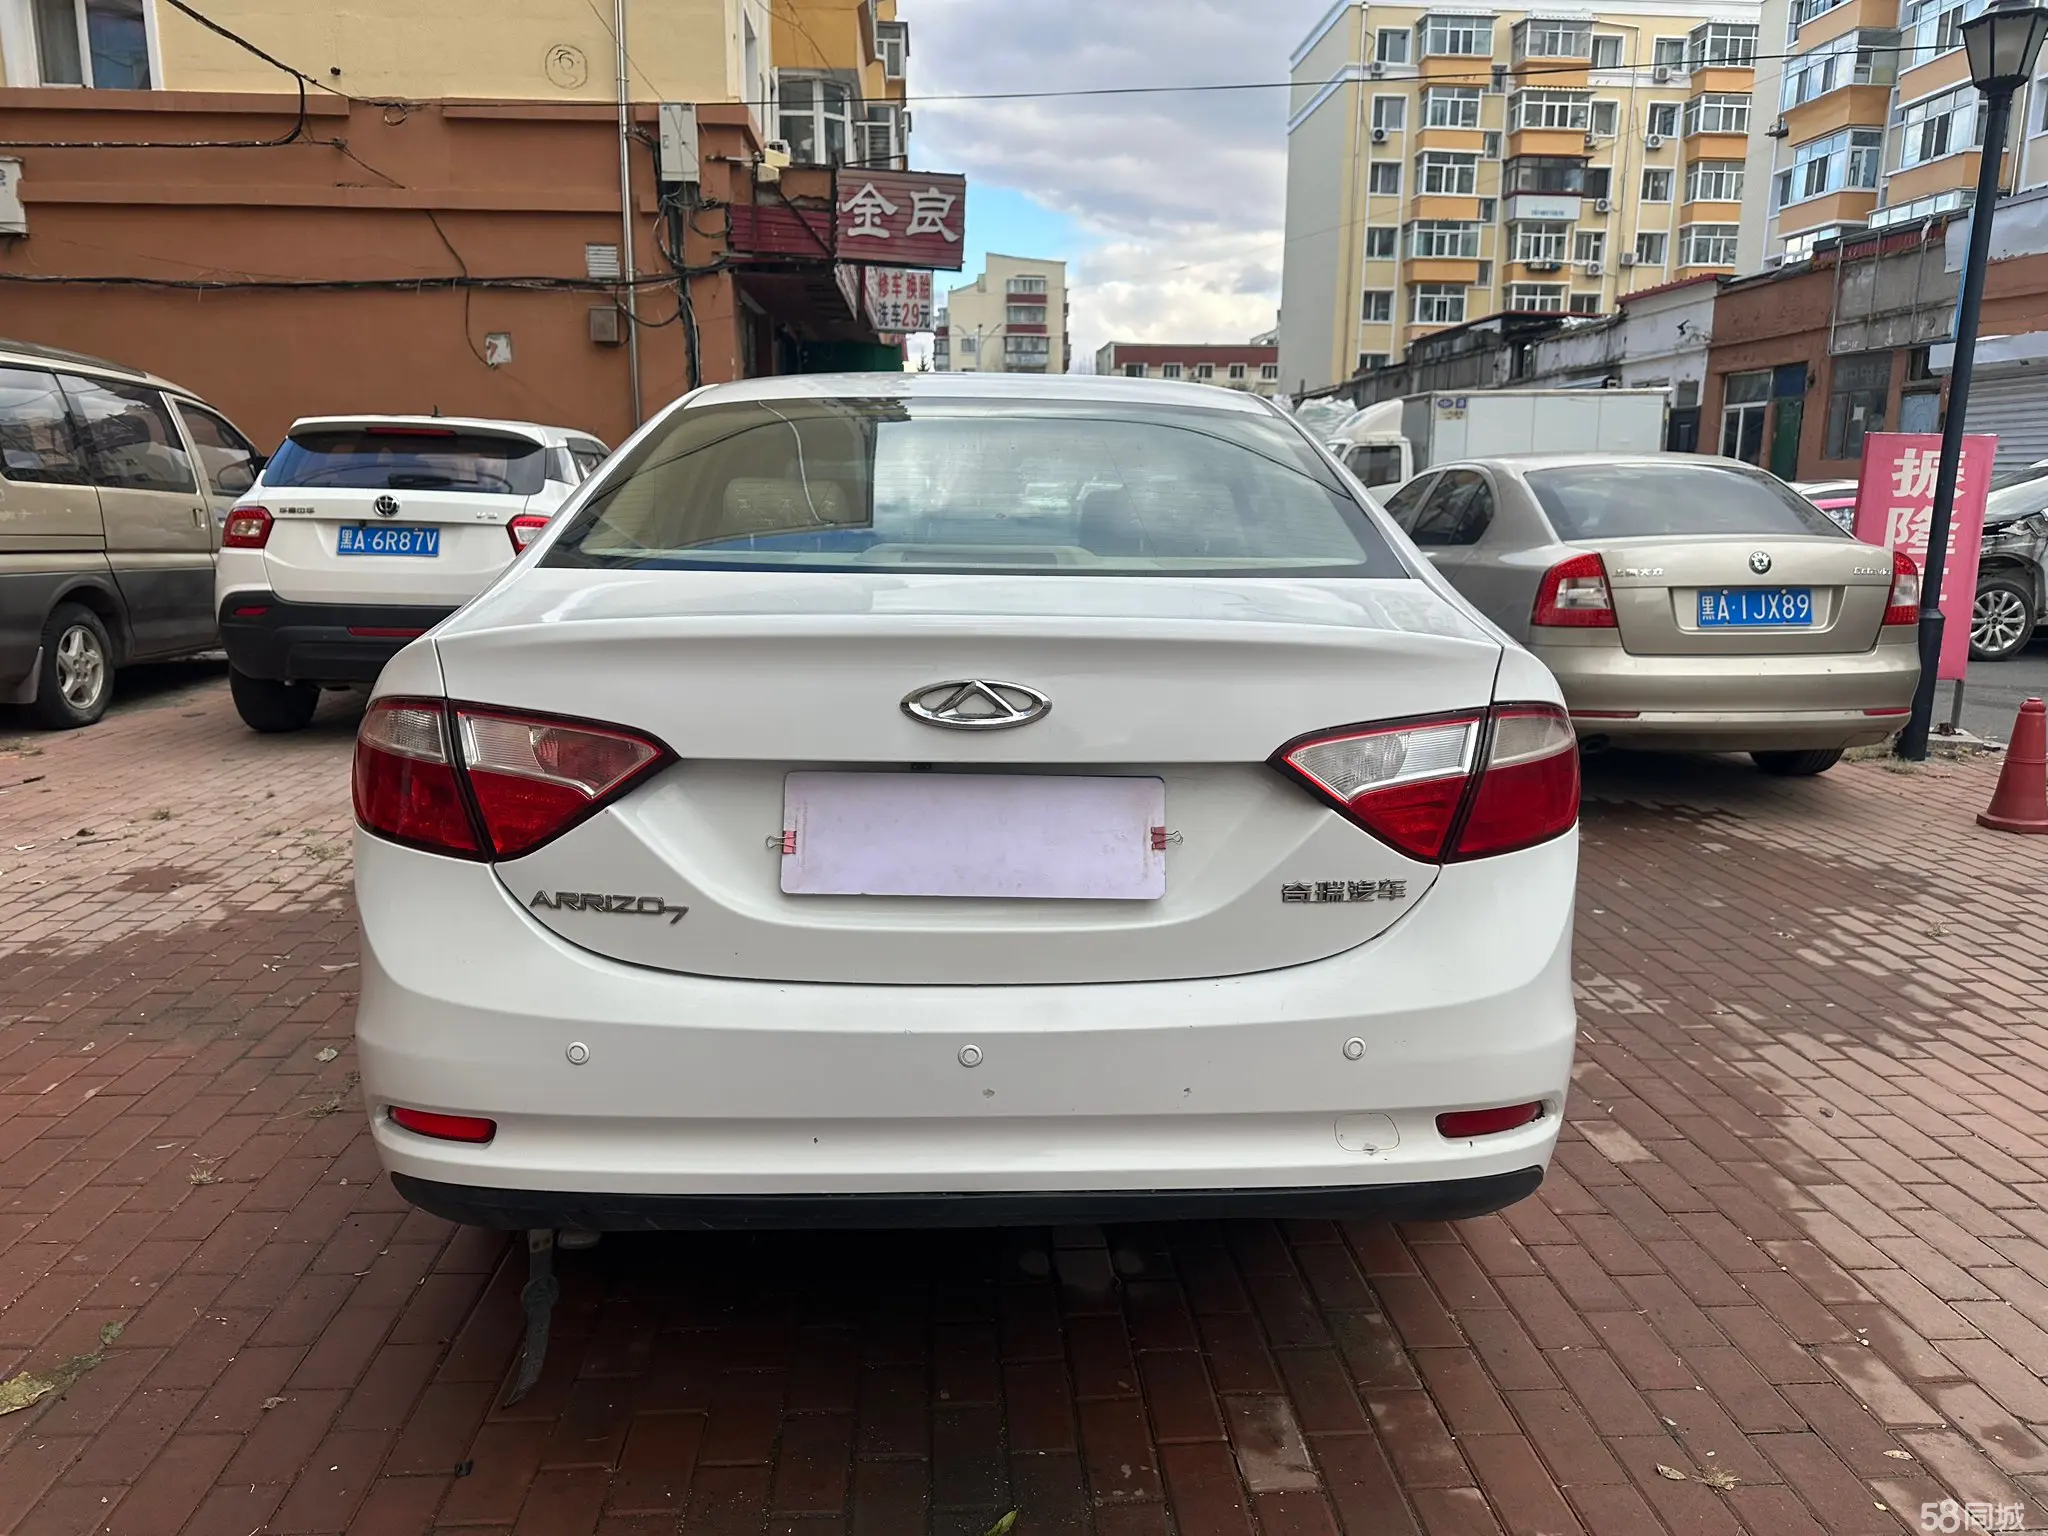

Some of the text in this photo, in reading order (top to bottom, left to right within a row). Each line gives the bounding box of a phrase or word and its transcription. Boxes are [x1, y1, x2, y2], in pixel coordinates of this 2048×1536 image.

[841, 181, 960, 244] 金良
[1281, 878, 1408, 903] 奇瑞汽车
